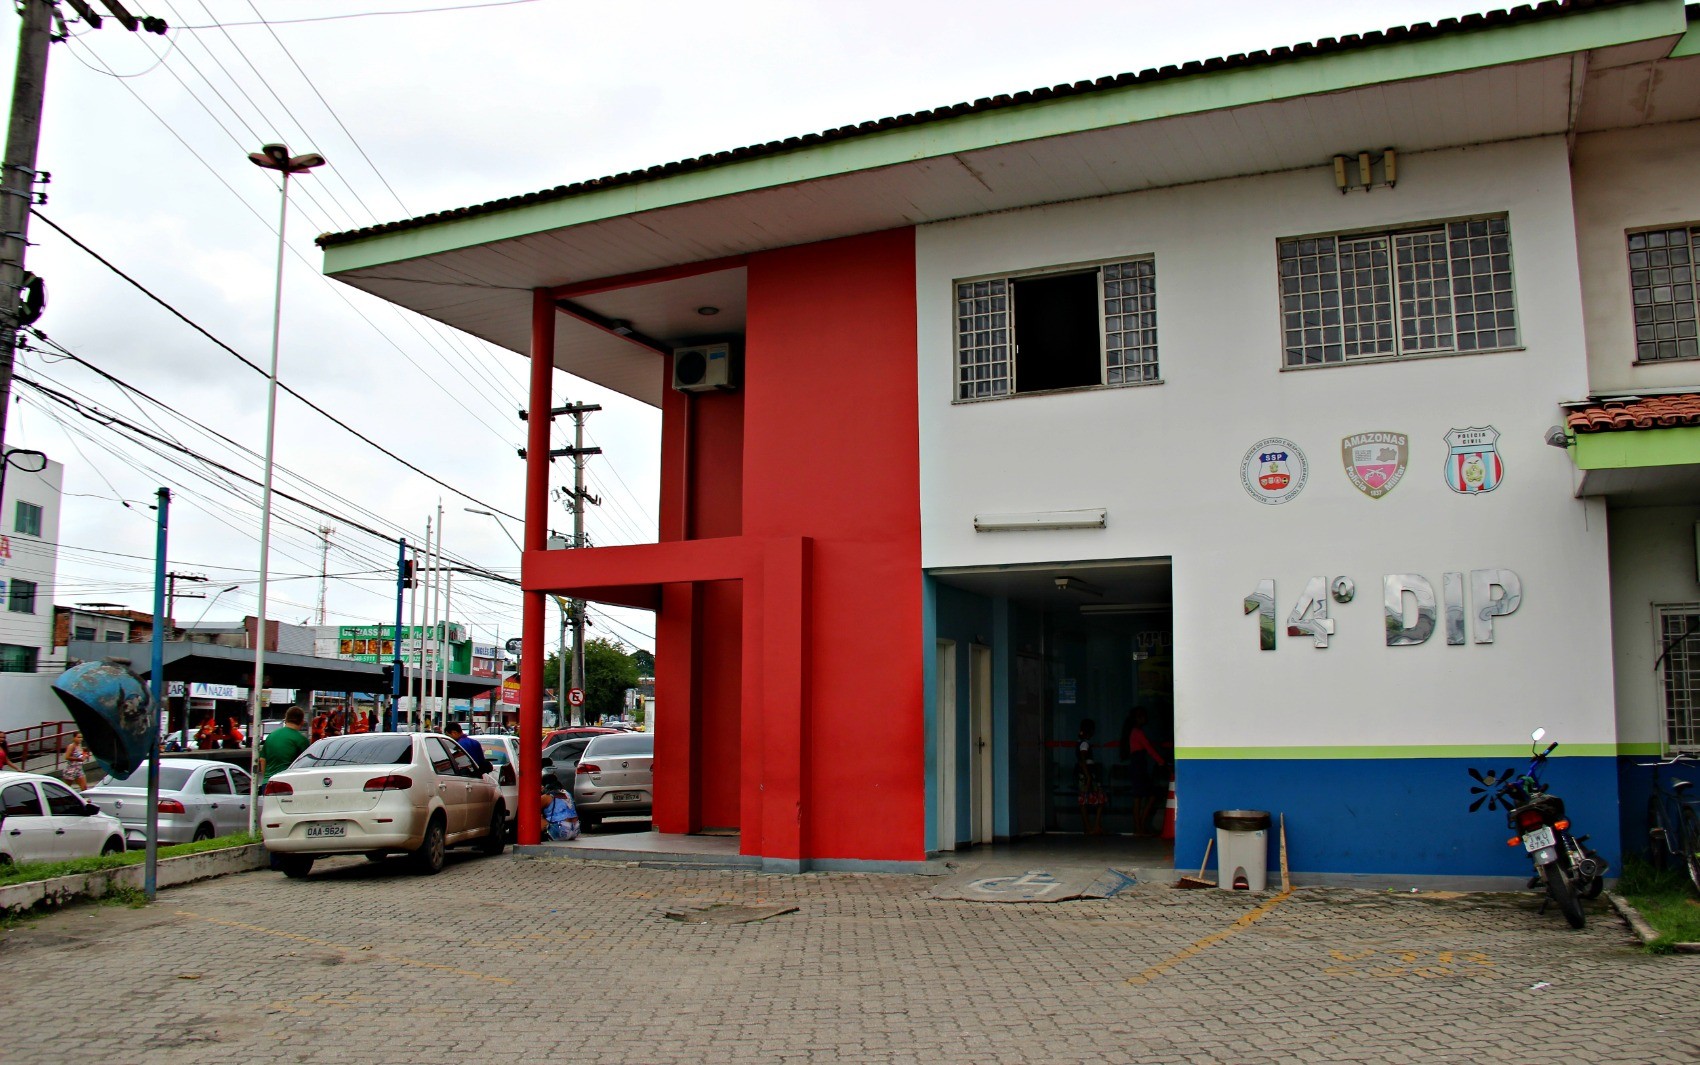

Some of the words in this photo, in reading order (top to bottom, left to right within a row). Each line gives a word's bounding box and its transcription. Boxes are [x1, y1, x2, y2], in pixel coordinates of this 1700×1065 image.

[1344, 433, 1405, 449] AMAZONAS
[1384, 464, 1405, 491] Militar
[1383, 568, 1522, 647] DIP
[307, 827, 345, 836] OAA-9624
